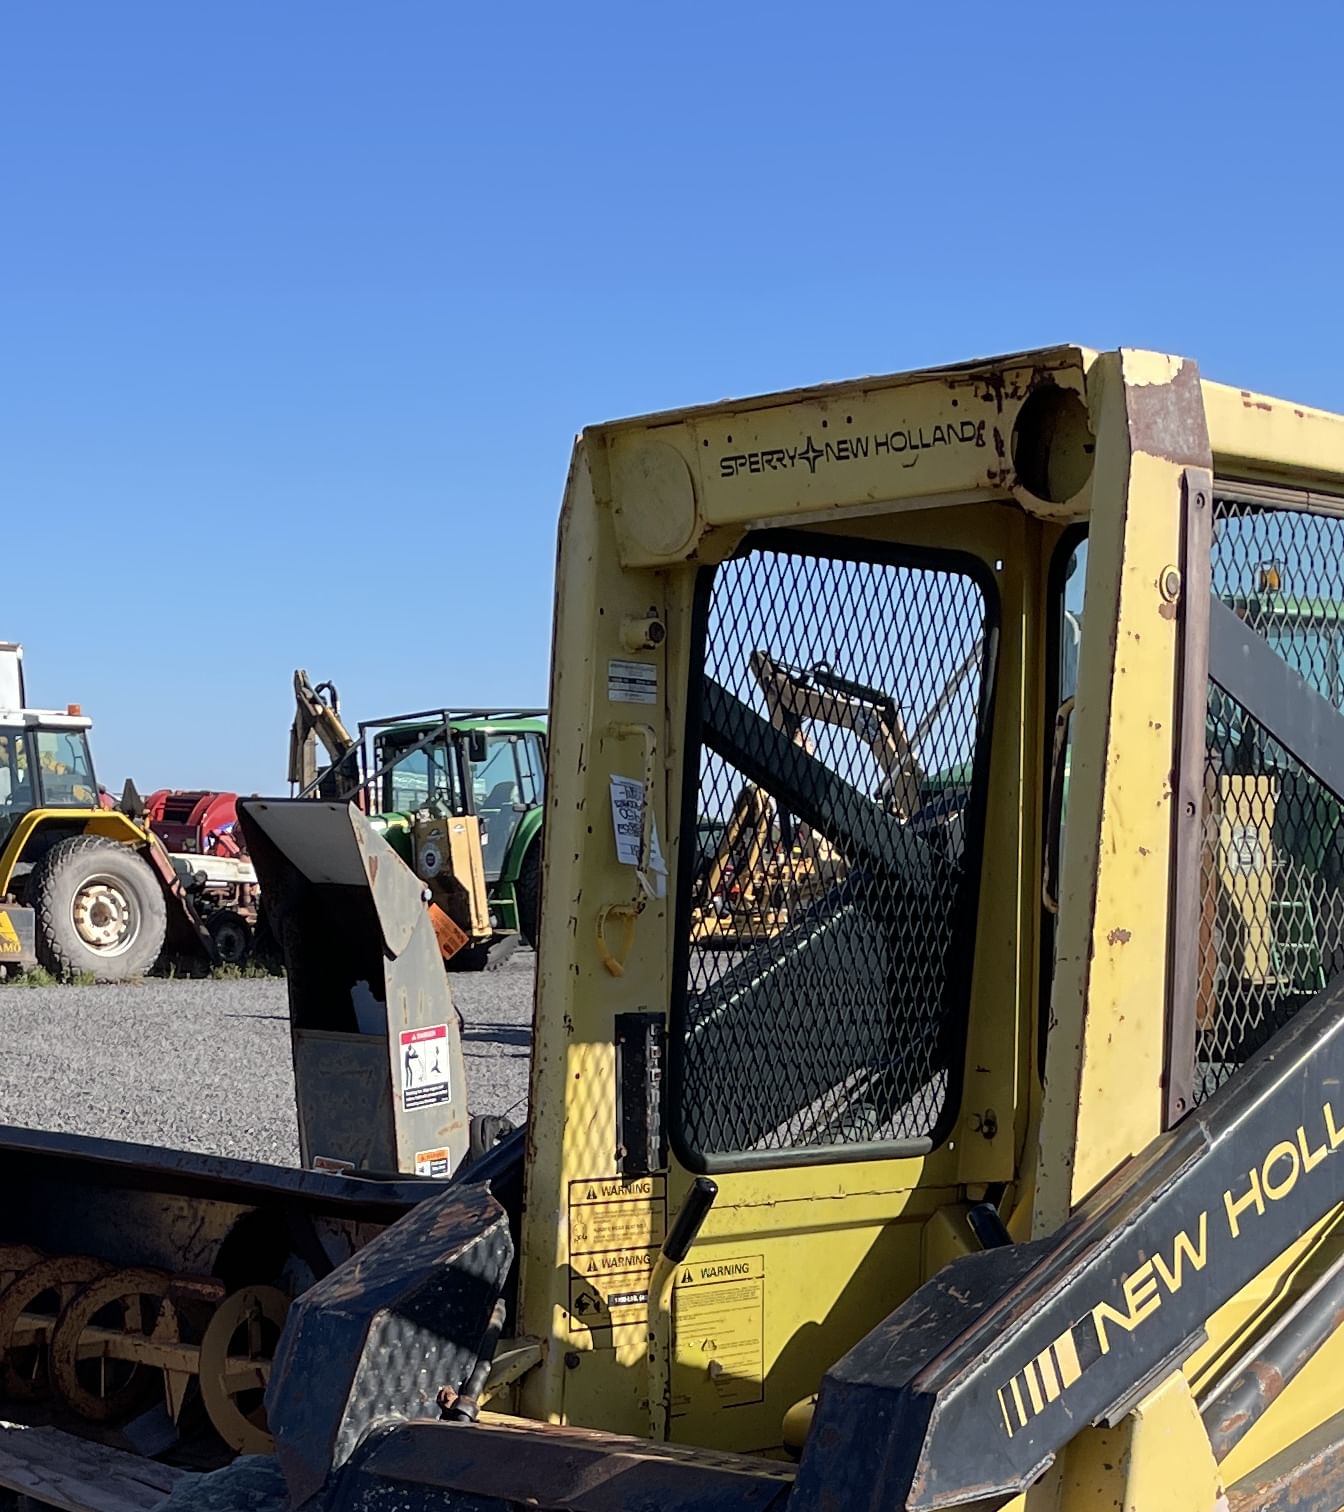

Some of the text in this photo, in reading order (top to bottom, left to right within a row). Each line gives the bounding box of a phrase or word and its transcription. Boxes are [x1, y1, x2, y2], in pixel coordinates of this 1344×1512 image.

[719, 420, 978, 478] SPERRY NEW HOLLAND
[601, 1182, 651, 1198] WARNING
[601, 1254, 651, 1270] WARNING
[700, 1262, 750, 1279] WARNING
[1091, 1211, 1207, 1355] NEW
